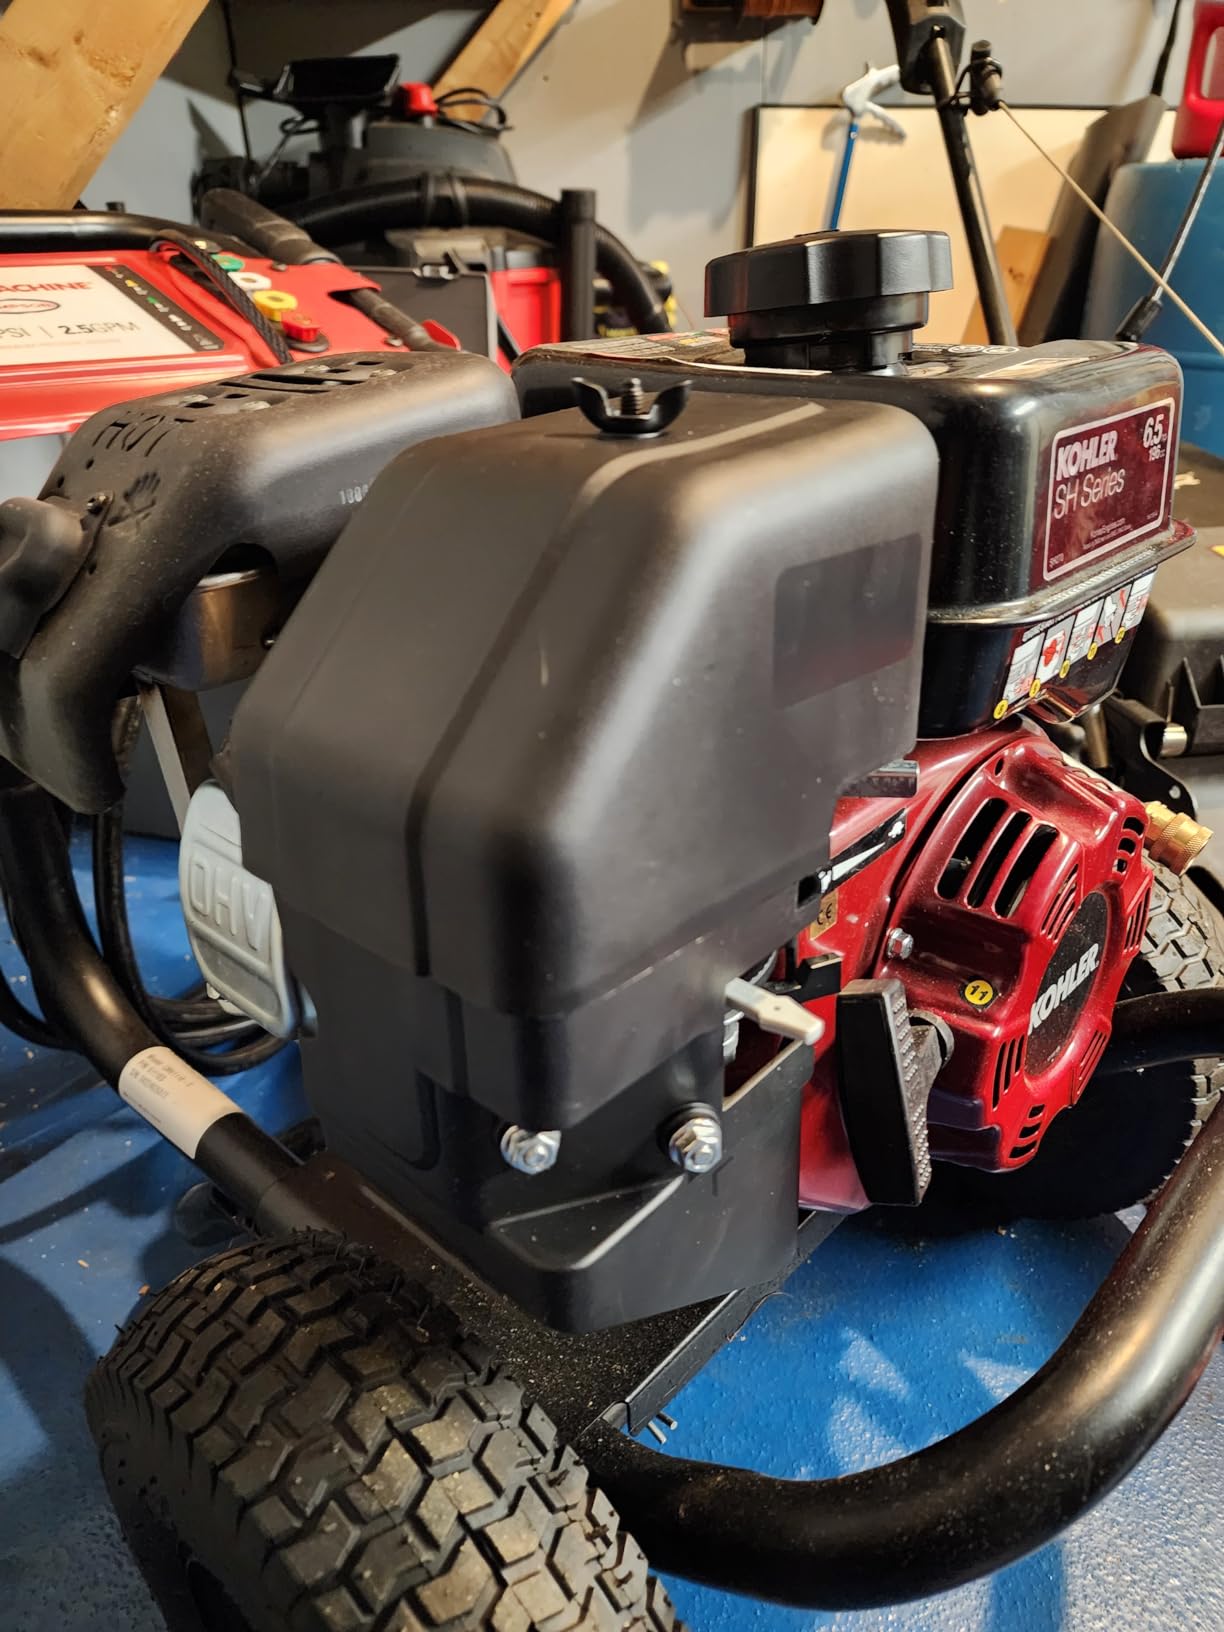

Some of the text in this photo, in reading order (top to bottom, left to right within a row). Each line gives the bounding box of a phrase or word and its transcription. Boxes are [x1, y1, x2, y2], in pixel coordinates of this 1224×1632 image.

[92, 414, 196, 457] HOT
[1056, 430, 1118, 481] KOHLER
[1053, 467, 1125, 519] SH Series
[189, 860, 272, 952] OHV
[969, 984, 990, 1002] 11
[1027, 943, 1100, 1036] KOHLER
